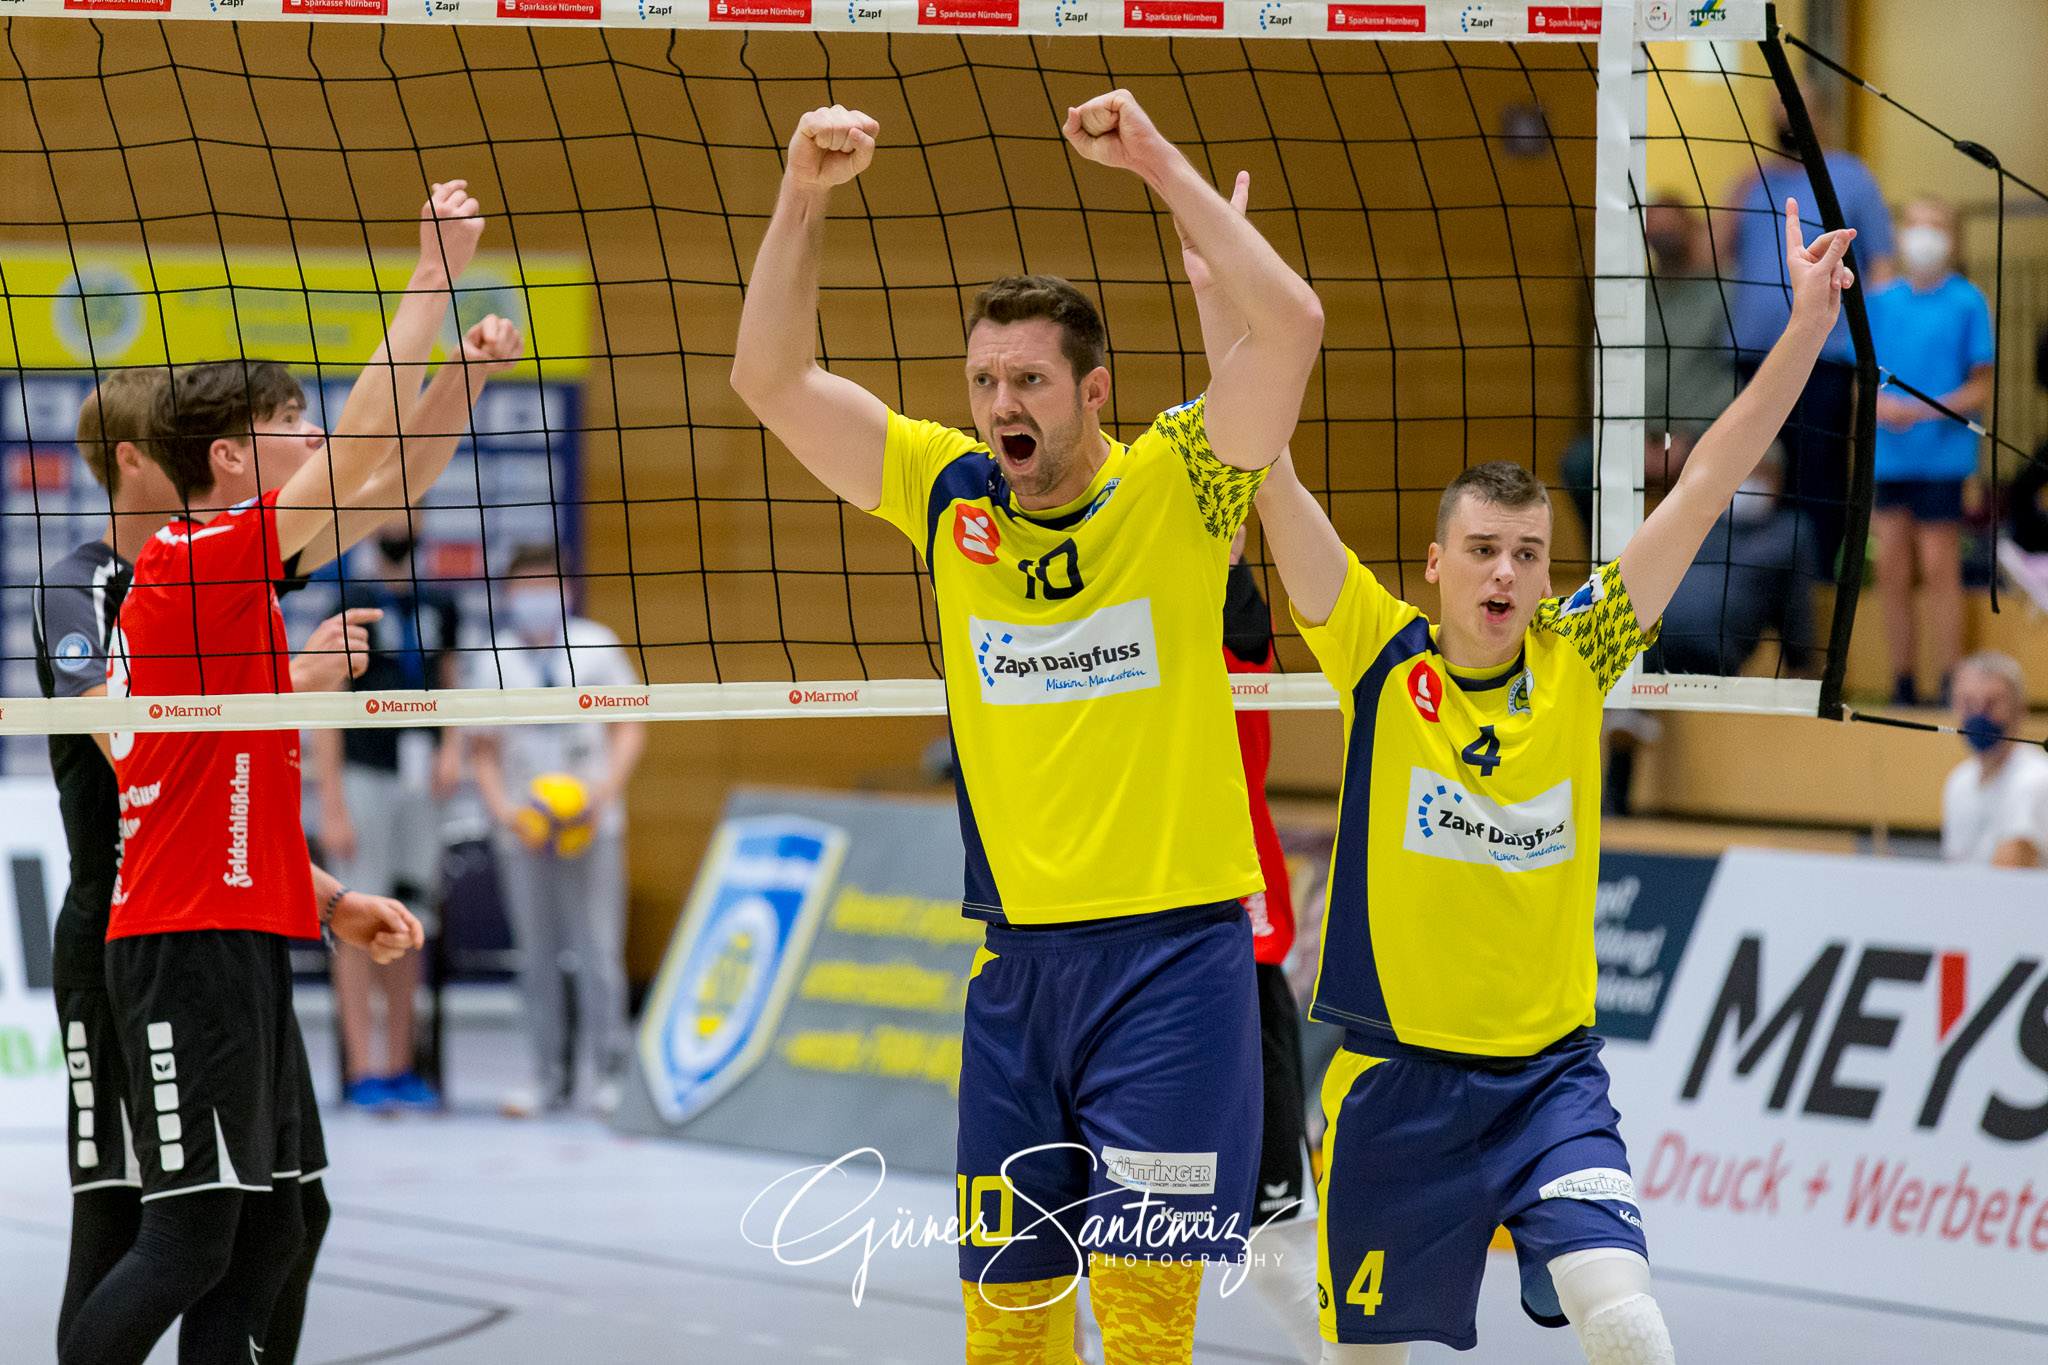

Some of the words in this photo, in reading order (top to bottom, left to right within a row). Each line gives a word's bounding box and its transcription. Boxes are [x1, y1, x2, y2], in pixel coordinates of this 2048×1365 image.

[304, 0, 343, 8] Sparkasse
[344, 0, 382, 9] Nürnberg
[435, 1, 460, 11] Zapf
[519, 2, 558, 11] Sparkasse
[558, 3, 594, 13] Nürnberg
[648, 5, 673, 16] Zapf
[731, 6, 769, 16] Sparkasse
[770, 7, 805, 18] Nürnberg
[858, 9, 882, 19] Zapf
[939, 10, 976, 20] Sparkasse
[977, 10, 1013, 21] Nürnberg
[1064, 13, 1089, 23] Zapf
[1145, 13, 1182, 22] Sparkasse
[1183, 13, 1218, 24] Nürnberg
[1269, 16, 1293, 26] Zapf
[1348, 16, 1385, 25] Sparkasse
[1386, 16, 1419, 26] Nürnberg
[1470, 18, 1494, 28] Zapf
[1017, 537, 1085, 600] 10
[993, 655, 1039, 678] Zapf
[1040, 642, 1141, 673] Daigfuss
[1230, 683, 1269, 696] armot
[1632, 683, 1668, 696] armot
[594, 694, 650, 708] Marmot
[804, 690, 859, 703] Marmot
[164, 705, 222, 719] Marmot
[381, 700, 438, 713] Marmot
[1461, 724, 1502, 777] 4
[223, 752, 253, 888] Feldschlößchen
[1438, 809, 1485, 840] Zapf
[1488, 820, 1566, 851] Daigfs
[1641, 1131, 1793, 1216] Druck
[958, 1173, 1014, 1248] 10
[1161, 1206, 1213, 1223] Kempa
[1346, 1250, 1386, 1316] 4
